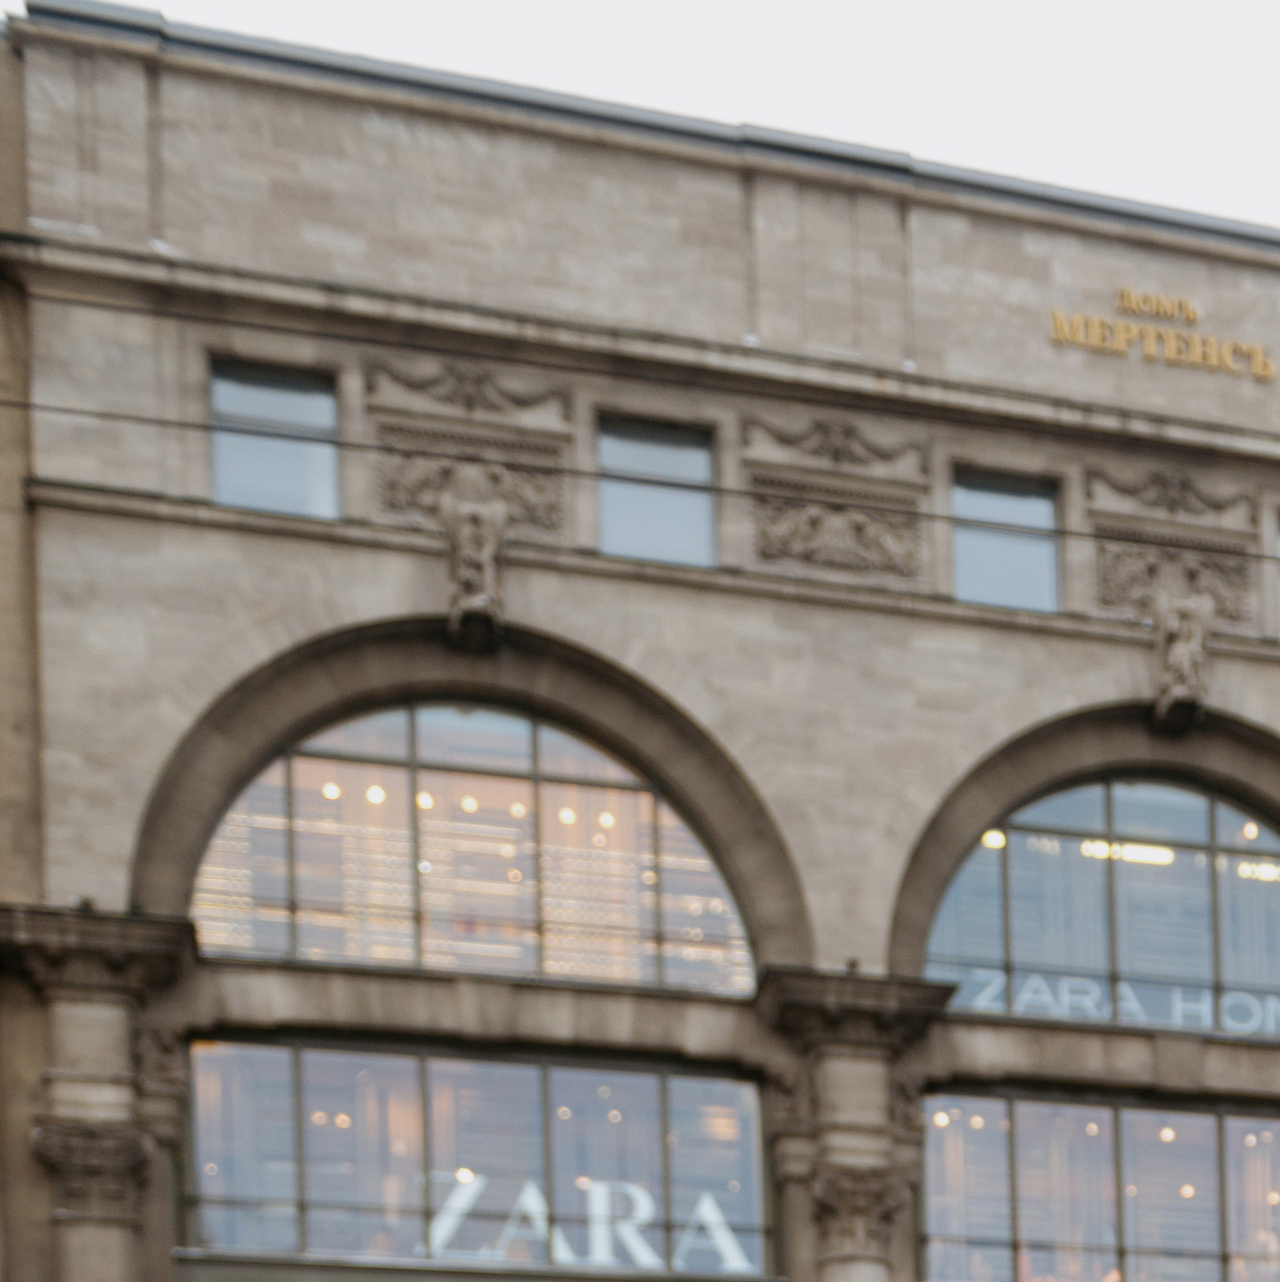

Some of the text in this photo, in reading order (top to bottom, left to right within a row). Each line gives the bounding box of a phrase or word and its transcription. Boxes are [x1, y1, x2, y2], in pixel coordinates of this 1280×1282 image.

[1050, 309, 1278, 383] МЕРТЕНСЪ
[969, 968, 1149, 1024] ZARA
[414, 1171, 760, 1275] ZARA
